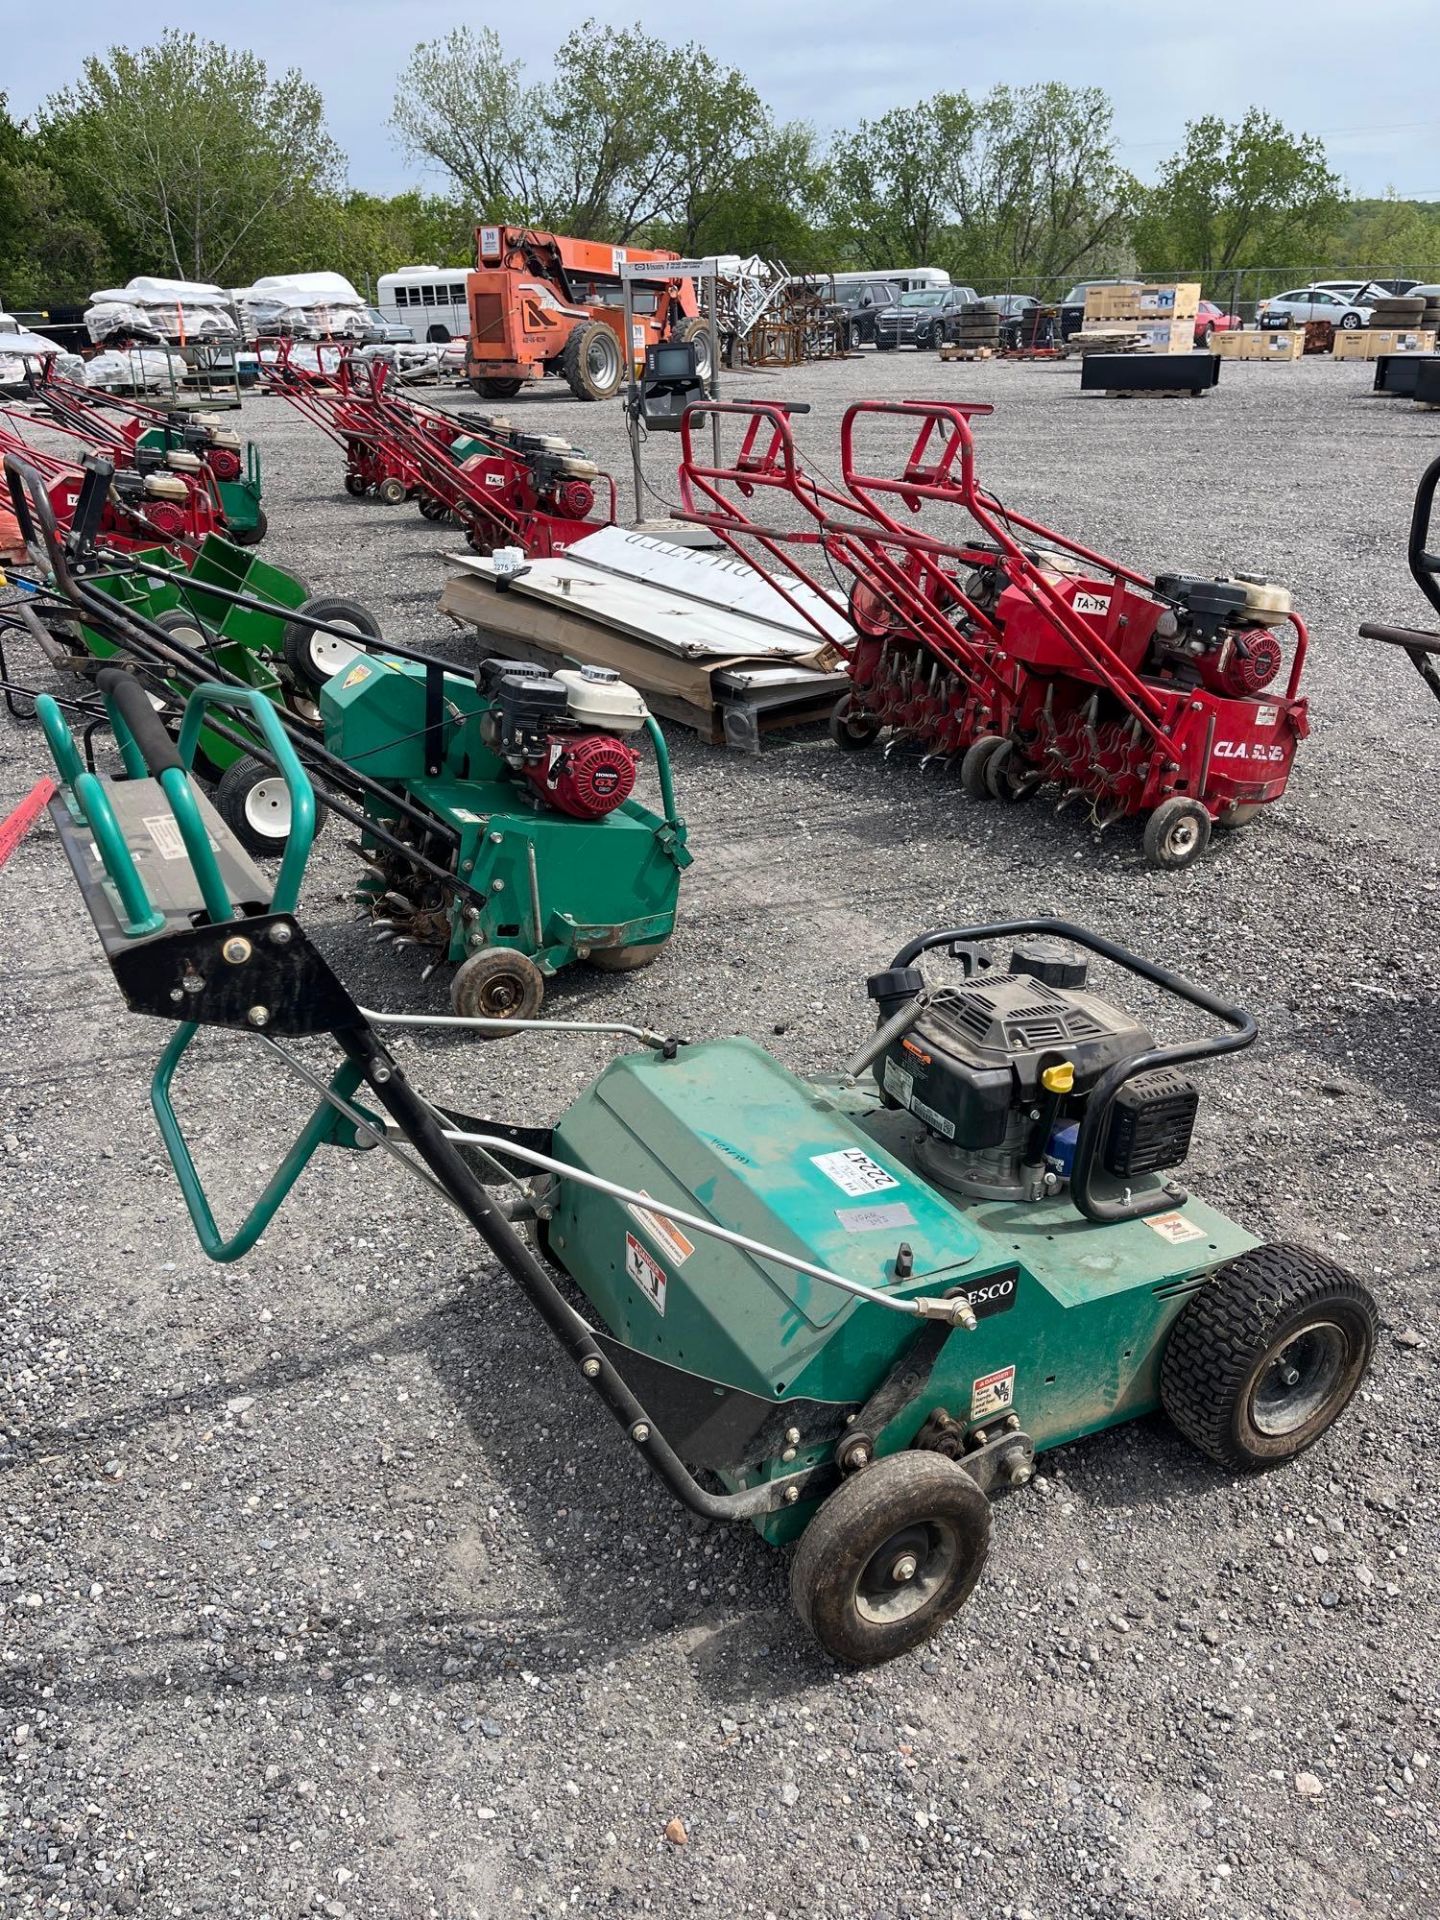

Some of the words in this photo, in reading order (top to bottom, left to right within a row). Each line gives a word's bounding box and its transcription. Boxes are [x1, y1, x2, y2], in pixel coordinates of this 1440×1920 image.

[1144, 1072, 1178, 1085] HOT
[842, 1152, 895, 1186] 22247
[967, 1279, 1014, 1306] ESCO
[984, 1371, 1009, 1385] DANGER
